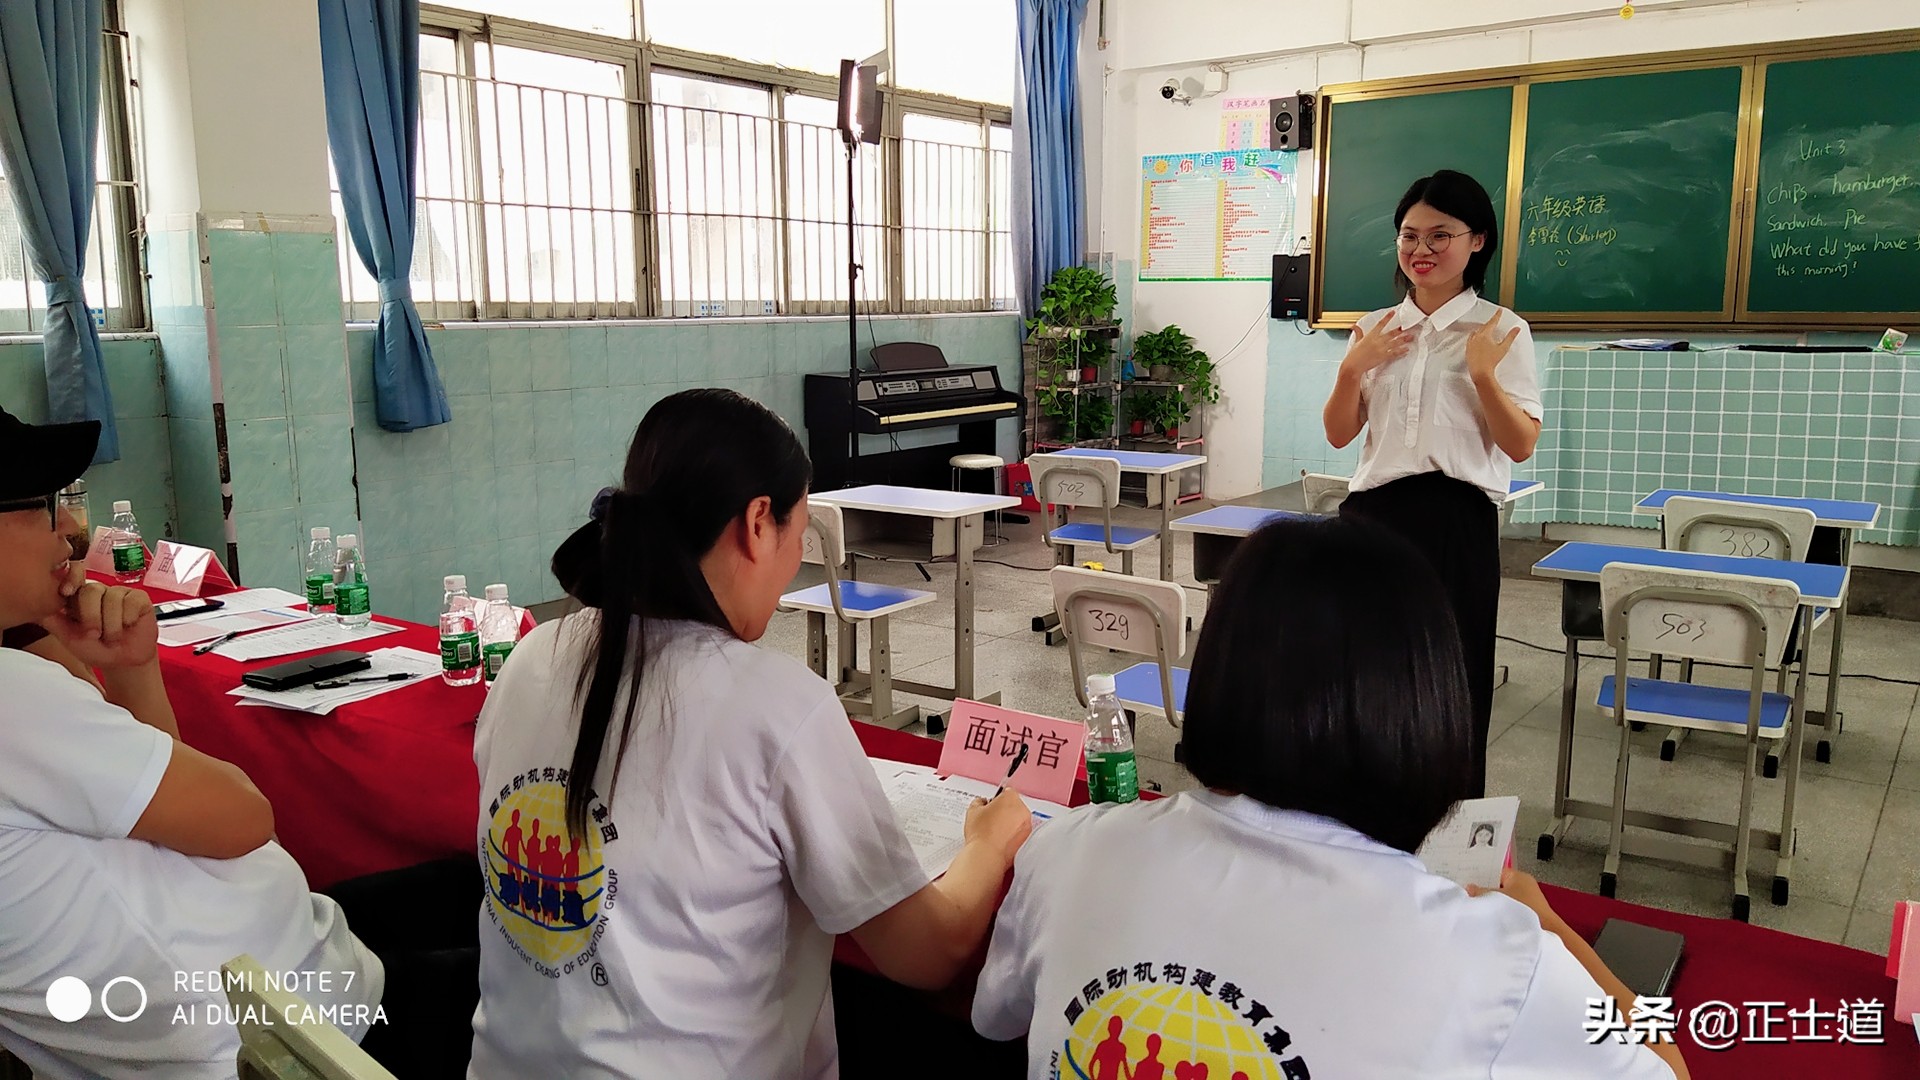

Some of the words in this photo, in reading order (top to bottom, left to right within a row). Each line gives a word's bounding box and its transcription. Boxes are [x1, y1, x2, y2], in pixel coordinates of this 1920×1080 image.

[1226, 99, 1270, 108] 汉字笔画名
[1800, 139, 1831, 160] Unit
[1837, 139, 1846, 154] 3
[1180, 153, 1259, 173] 你追我赶
[1527, 195, 1606, 221] 六年级英语
[1844, 208, 1867, 230] Pie
[1770, 237, 1811, 259] What
[1819, 236, 1838, 256] did
[1844, 241, 1867, 259] you
[1874, 233, 1907, 252] have
[1776, 264, 1796, 276] this
[1057, 479, 1085, 499] 503
[1719, 528, 1774, 559] 382
[1656, 613, 1707, 642] 503
[963, 715, 1069, 770] 面试官
[564, 961, 575, 975] OF
[604, 869, 619, 910] GROUP
